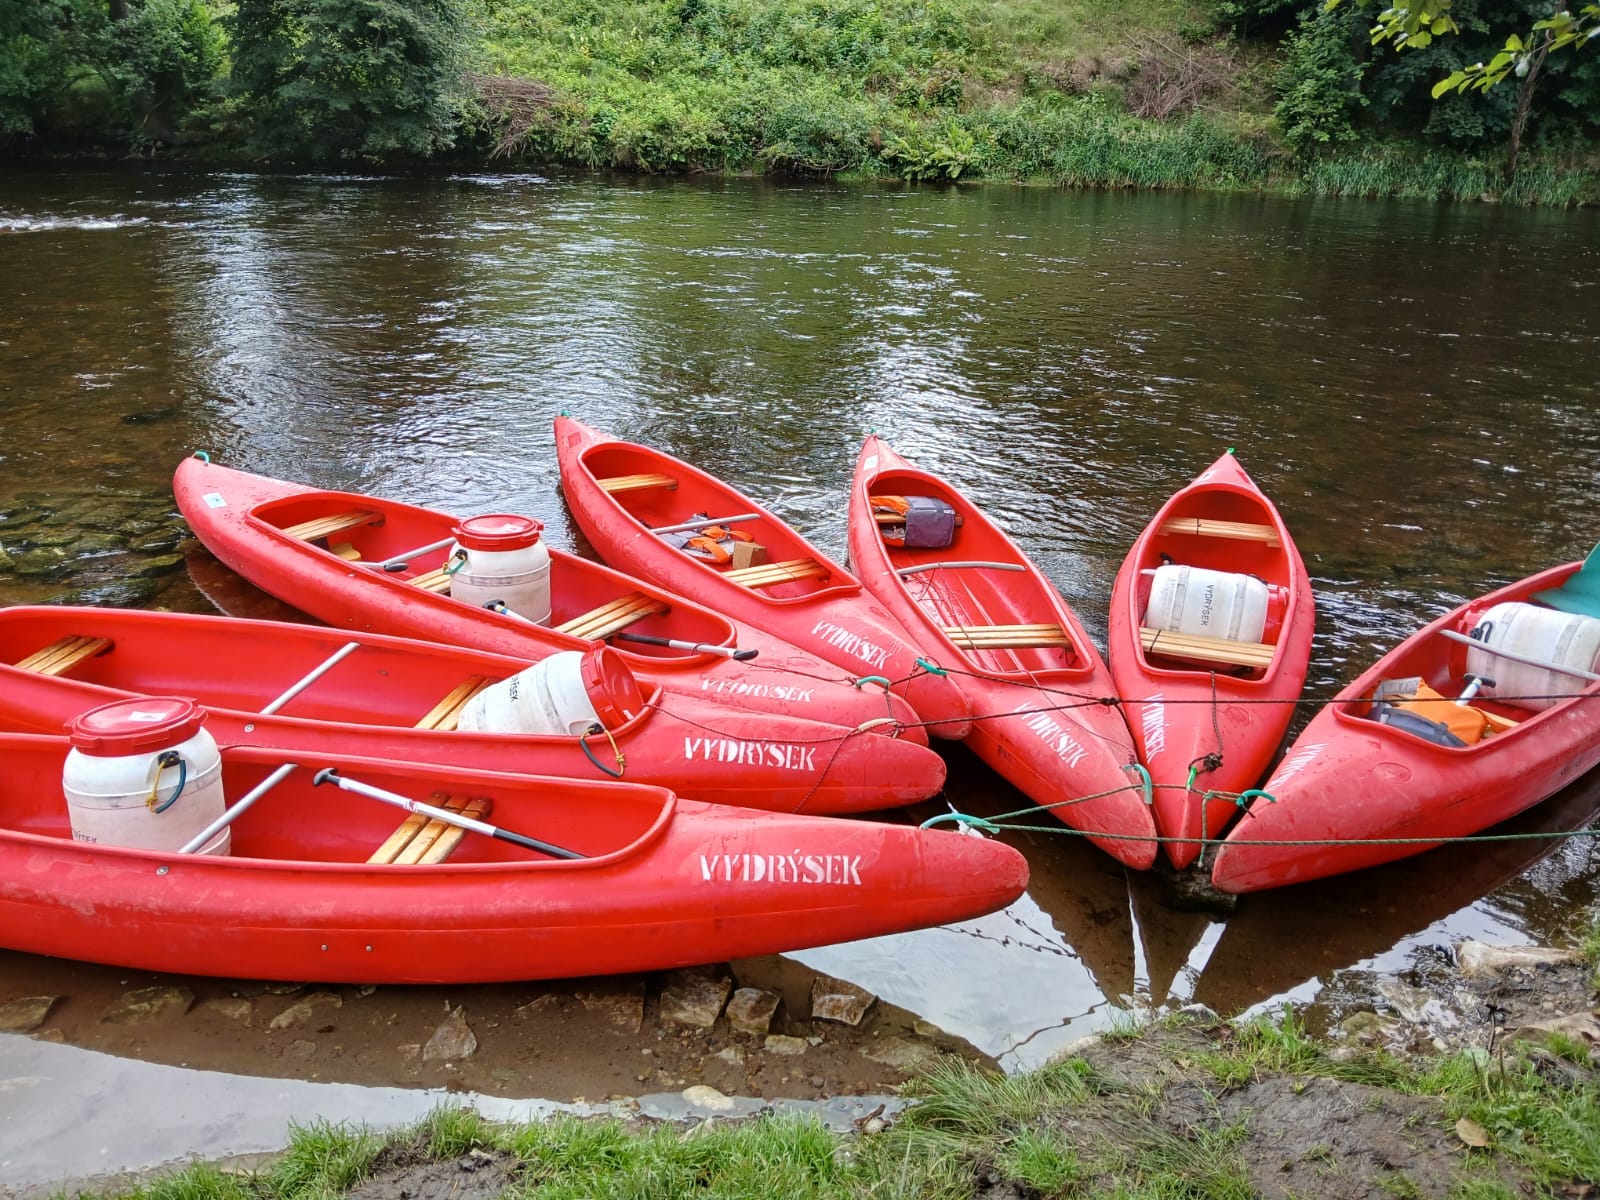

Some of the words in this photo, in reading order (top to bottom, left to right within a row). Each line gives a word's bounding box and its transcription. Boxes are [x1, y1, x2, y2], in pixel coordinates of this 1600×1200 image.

[811, 621, 891, 669] VYDRÝSEK
[684, 737, 816, 771] VYDRÝSEK
[1014, 701, 1088, 769] VYDRÝSEK
[700, 849, 861, 885] VYDRÝSEK
